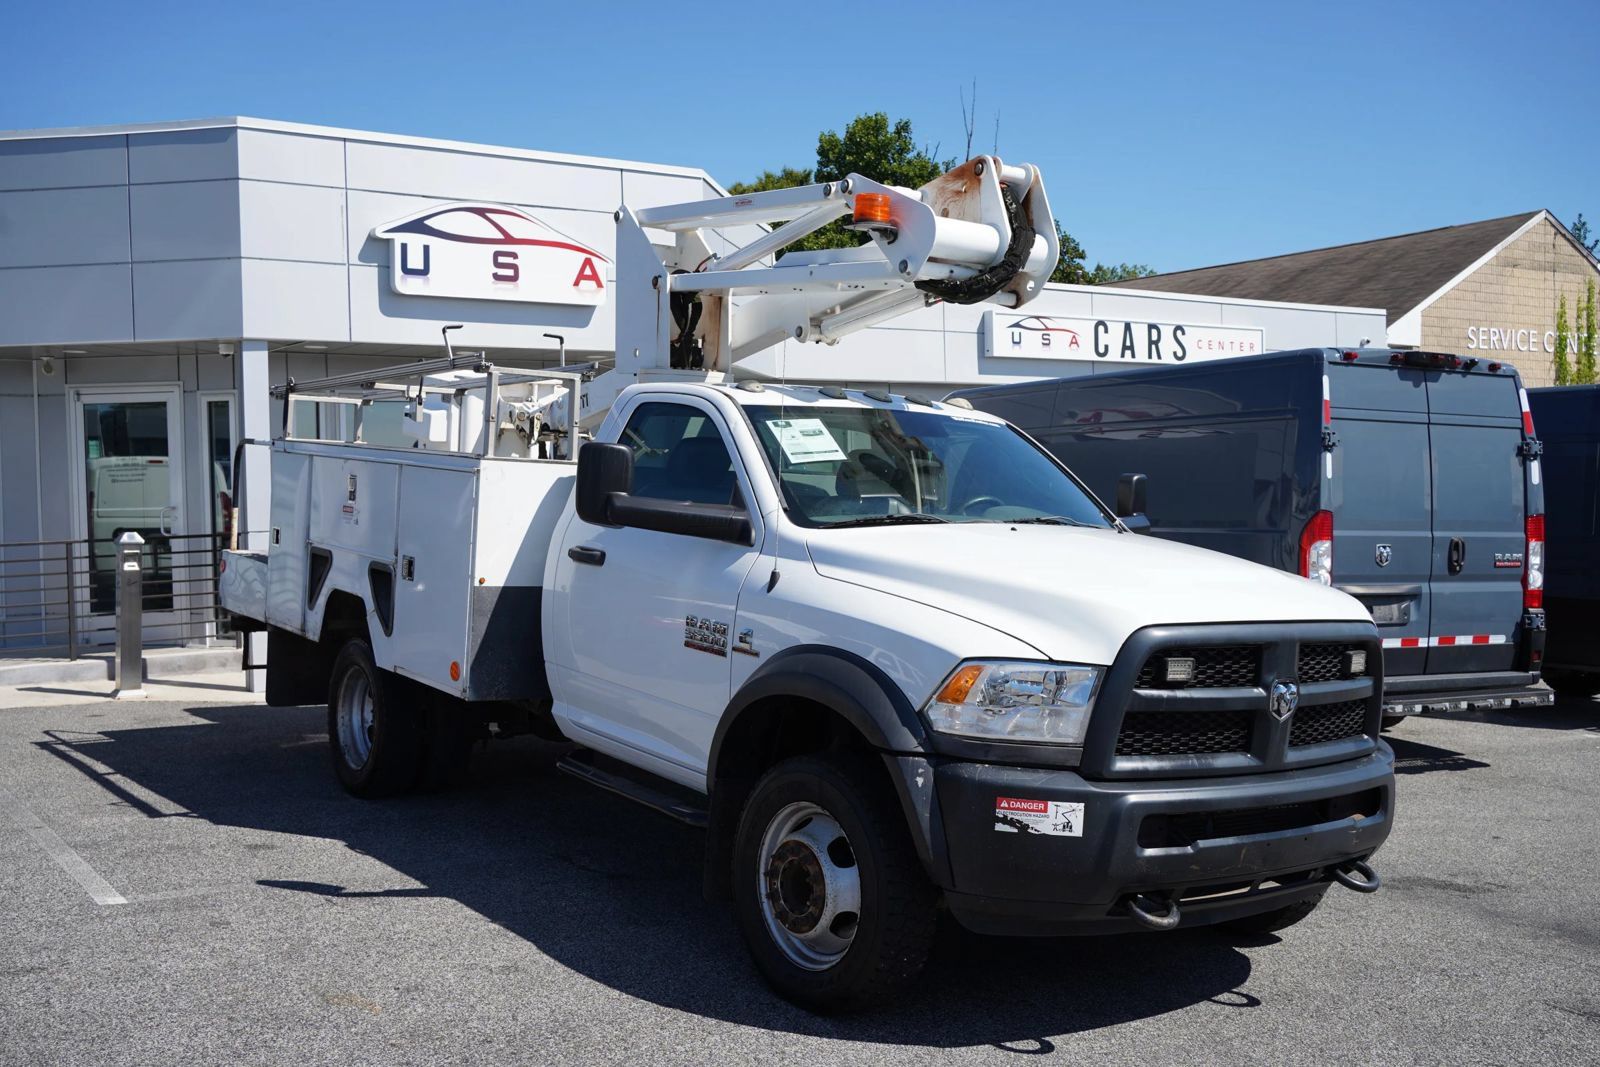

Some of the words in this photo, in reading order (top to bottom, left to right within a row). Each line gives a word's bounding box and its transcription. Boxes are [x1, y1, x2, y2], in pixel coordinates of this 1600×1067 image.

[1093, 319, 1188, 362] CARS
[1196, 339, 1255, 352] CENTER
[1467, 326, 1539, 352] SERVICE
[1494, 552, 1523, 561] RAM
[1009, 801, 1045, 811] DANGER
